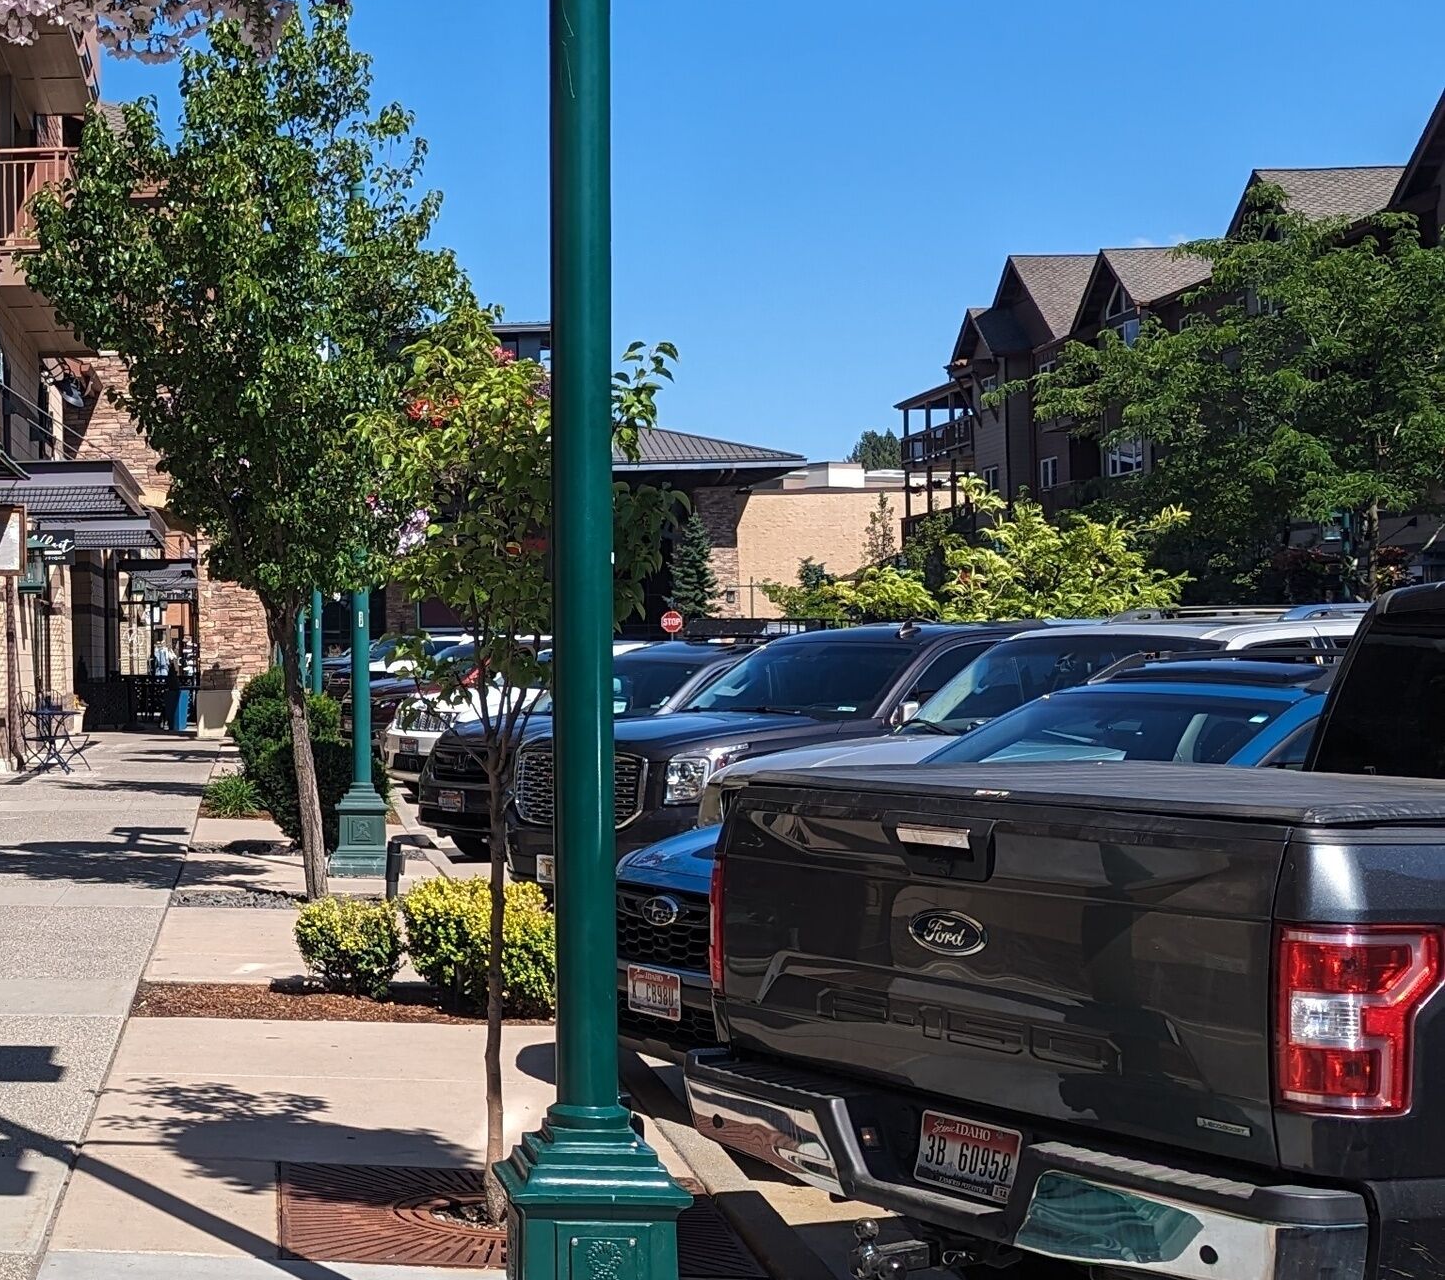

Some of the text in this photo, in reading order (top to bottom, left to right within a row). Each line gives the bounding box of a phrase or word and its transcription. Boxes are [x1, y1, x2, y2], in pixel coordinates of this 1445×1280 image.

[663, 618, 681, 626] STOP
[924, 920, 966, 947] Ford
[955, 1123, 991, 1141] IDAHO
[925, 1133, 1012, 1182] 3B 60958
